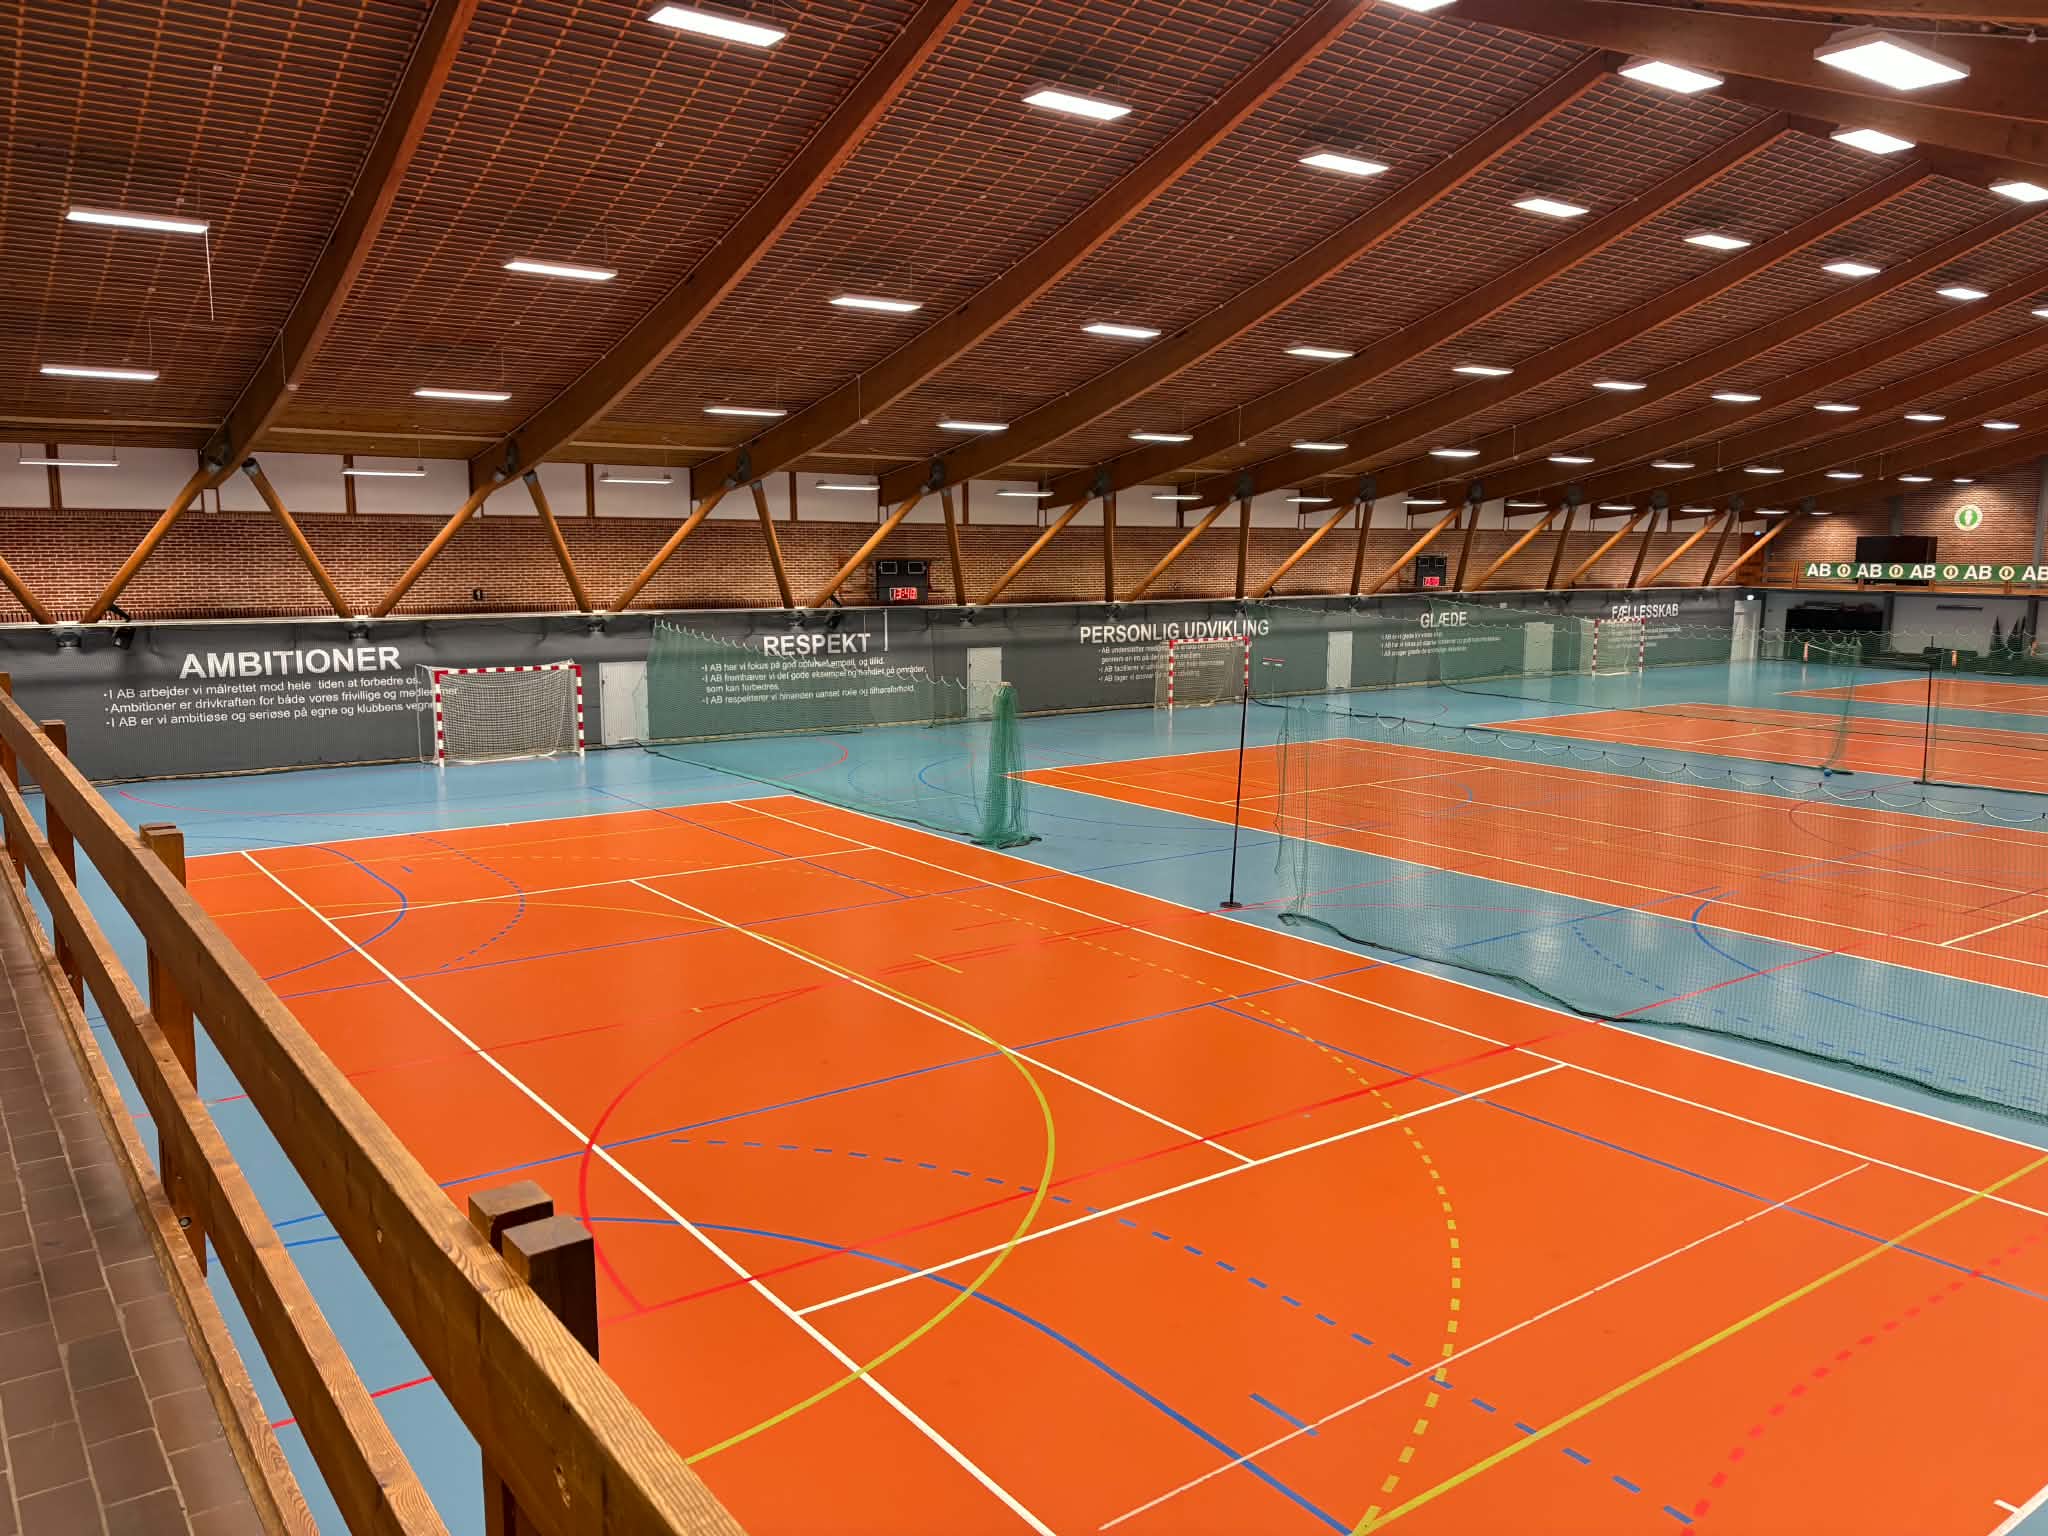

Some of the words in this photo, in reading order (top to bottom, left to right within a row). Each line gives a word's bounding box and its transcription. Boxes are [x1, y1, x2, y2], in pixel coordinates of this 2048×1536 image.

[1807, 563, 1832, 576] AB
[1856, 563, 1882, 578] AB
[1909, 564, 1936, 579] AB
[1963, 565, 1993, 580] AB
[2022, 566, 2048, 581] AB
[1420, 611, 1468, 628] GLÆDE
[1611, 603, 1679, 620] FÆLLESSKAB
[1079, 622, 1180, 644] PERSONLIG
[1184, 619, 1270, 639] UDVIKLING
[763, 632, 872, 657] RESPEKT
[178, 646, 403, 680] AMBITIONER
[710, 663, 722, 672] AB
[116, 688, 136, 700] AB
[139, 685, 190, 699] arbejder
[192, 684, 204, 695] vi
[206, 682, 257, 694] målrettet
[260, 681, 285, 692] mod
[287, 681, 312, 691] hele
[318, 679, 345, 689] tiden
[347, 678, 359, 688] at
[359, 676, 404, 687] forbedre
[710, 673, 722, 682] AB
[110, 700, 177, 713] Ambitioner
[179, 701, 193, 711] er
[195, 696, 257, 709] drivkraften
[259, 695, 275, 706] for
[277, 693, 306, 705] både
[308, 694, 339, 703] vores
[341, 689, 381, 703] frivillige
[383, 690, 397, 701] og
[710, 695, 723, 705] AB
[119, 716, 138, 727] AB
[140, 716, 153, 726] er
[156, 714, 168, 725] vi
[170, 711, 229, 724] ambitiøse
[231, 712, 247, 723] og
[249, 709, 291, 721] seriøse
[294, 706, 309, 719] på
[310, 707, 338, 718] egne
[340, 705, 354, 716] og
[357, 702, 404, 714] klubbens
